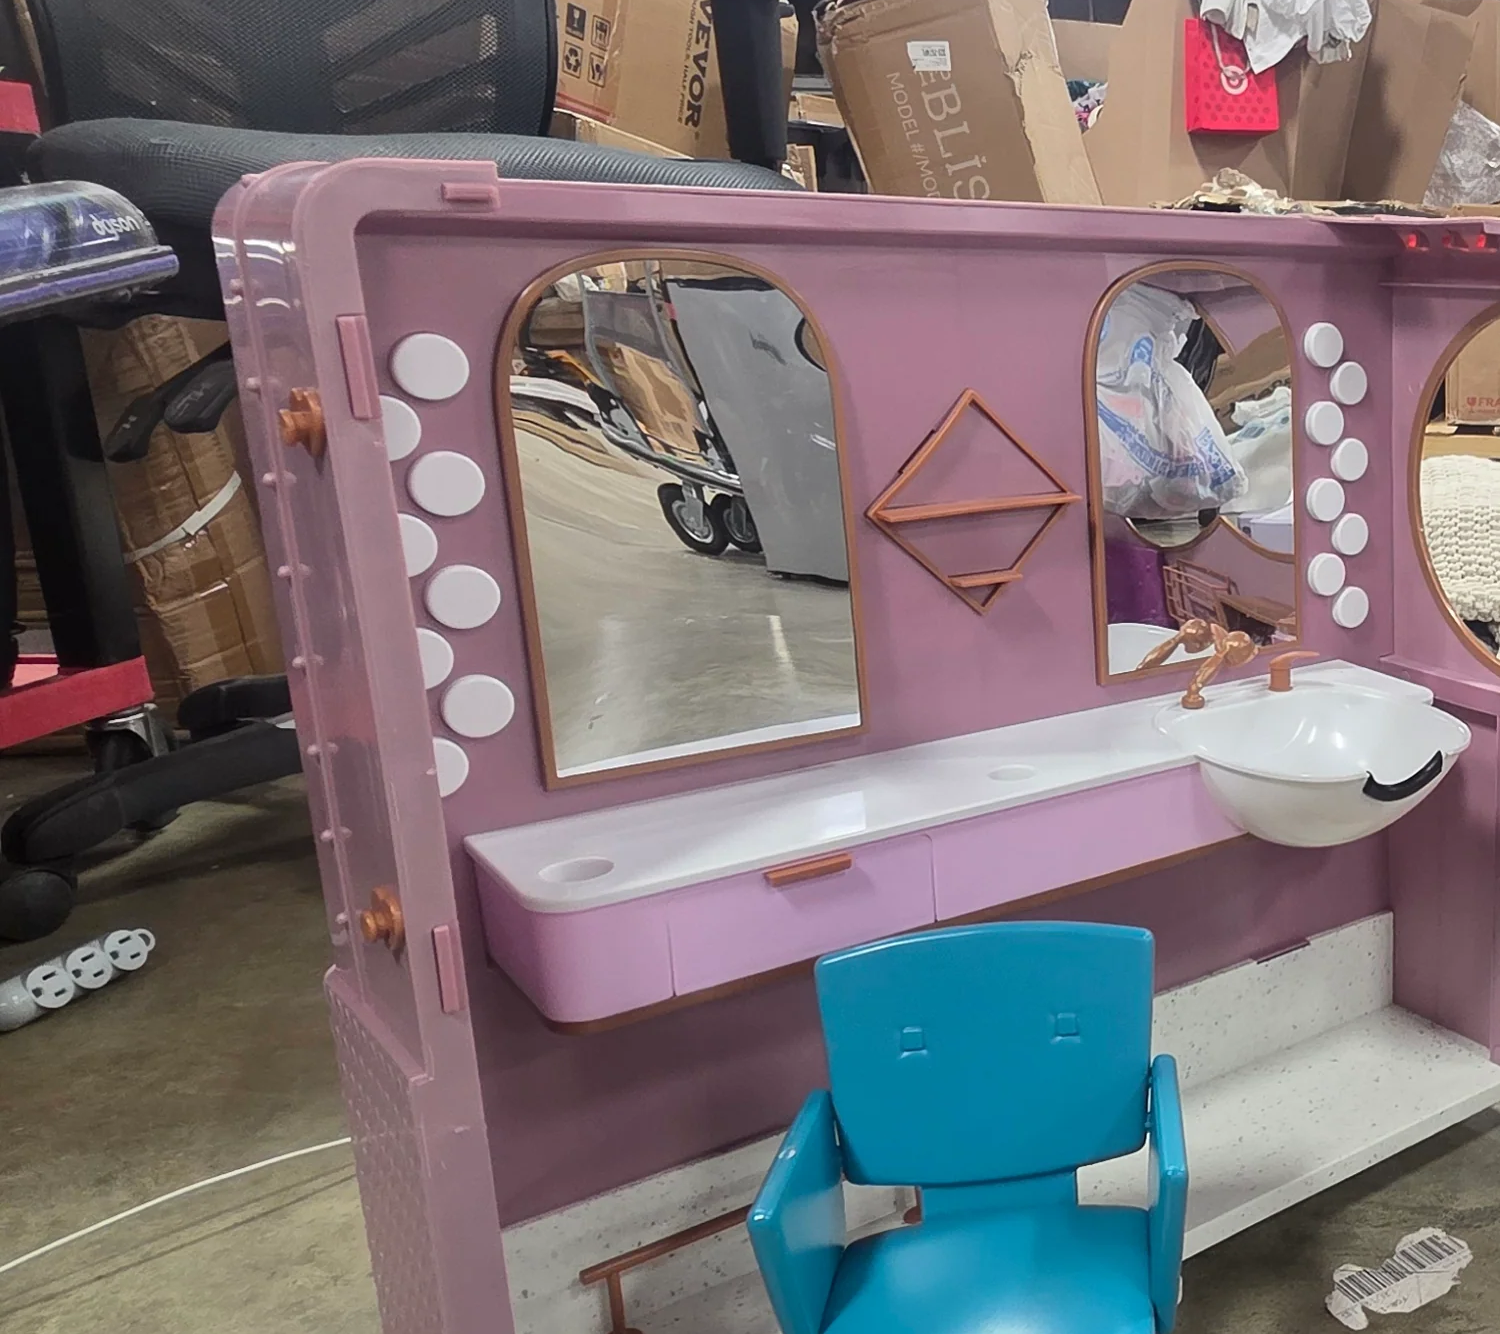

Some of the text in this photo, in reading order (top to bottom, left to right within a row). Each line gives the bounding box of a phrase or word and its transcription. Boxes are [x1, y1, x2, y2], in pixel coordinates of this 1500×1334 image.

[684, 0, 713, 128] VEVOR
[886, 71, 921, 142] MODEL
[88, 213, 141, 242] dyson
